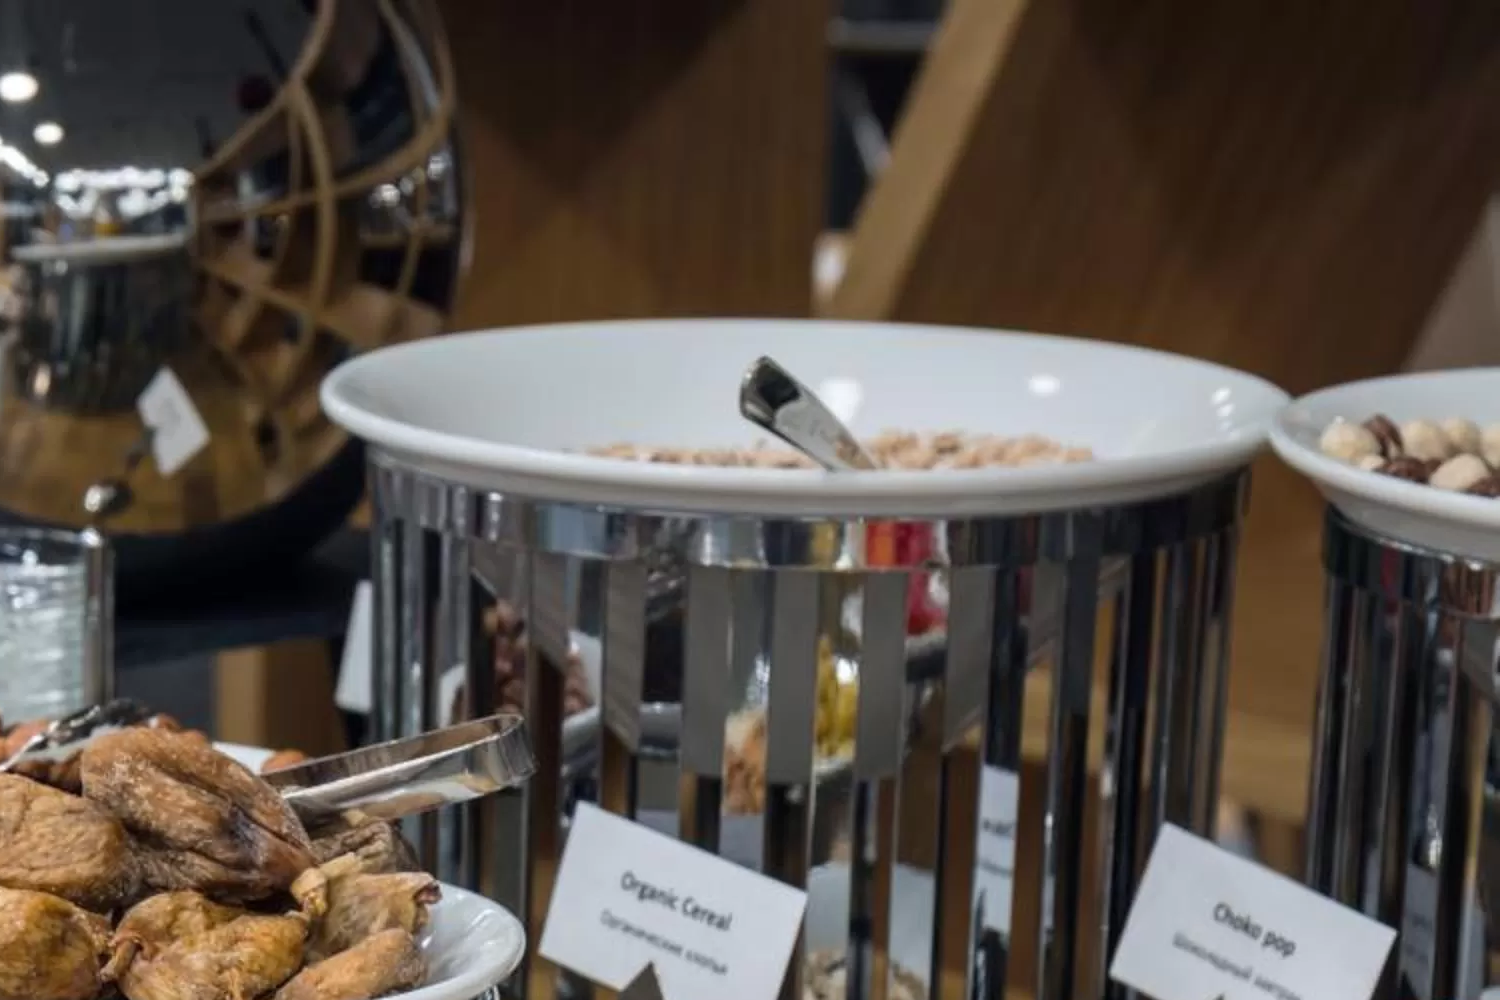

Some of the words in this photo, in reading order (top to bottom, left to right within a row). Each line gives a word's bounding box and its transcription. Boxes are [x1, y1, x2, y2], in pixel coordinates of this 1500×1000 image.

[621, 871, 679, 910] Organic
[682, 895, 733, 932] Cereal
[1214, 902, 1262, 940] Choko
[1262, 930, 1296, 958] pop
